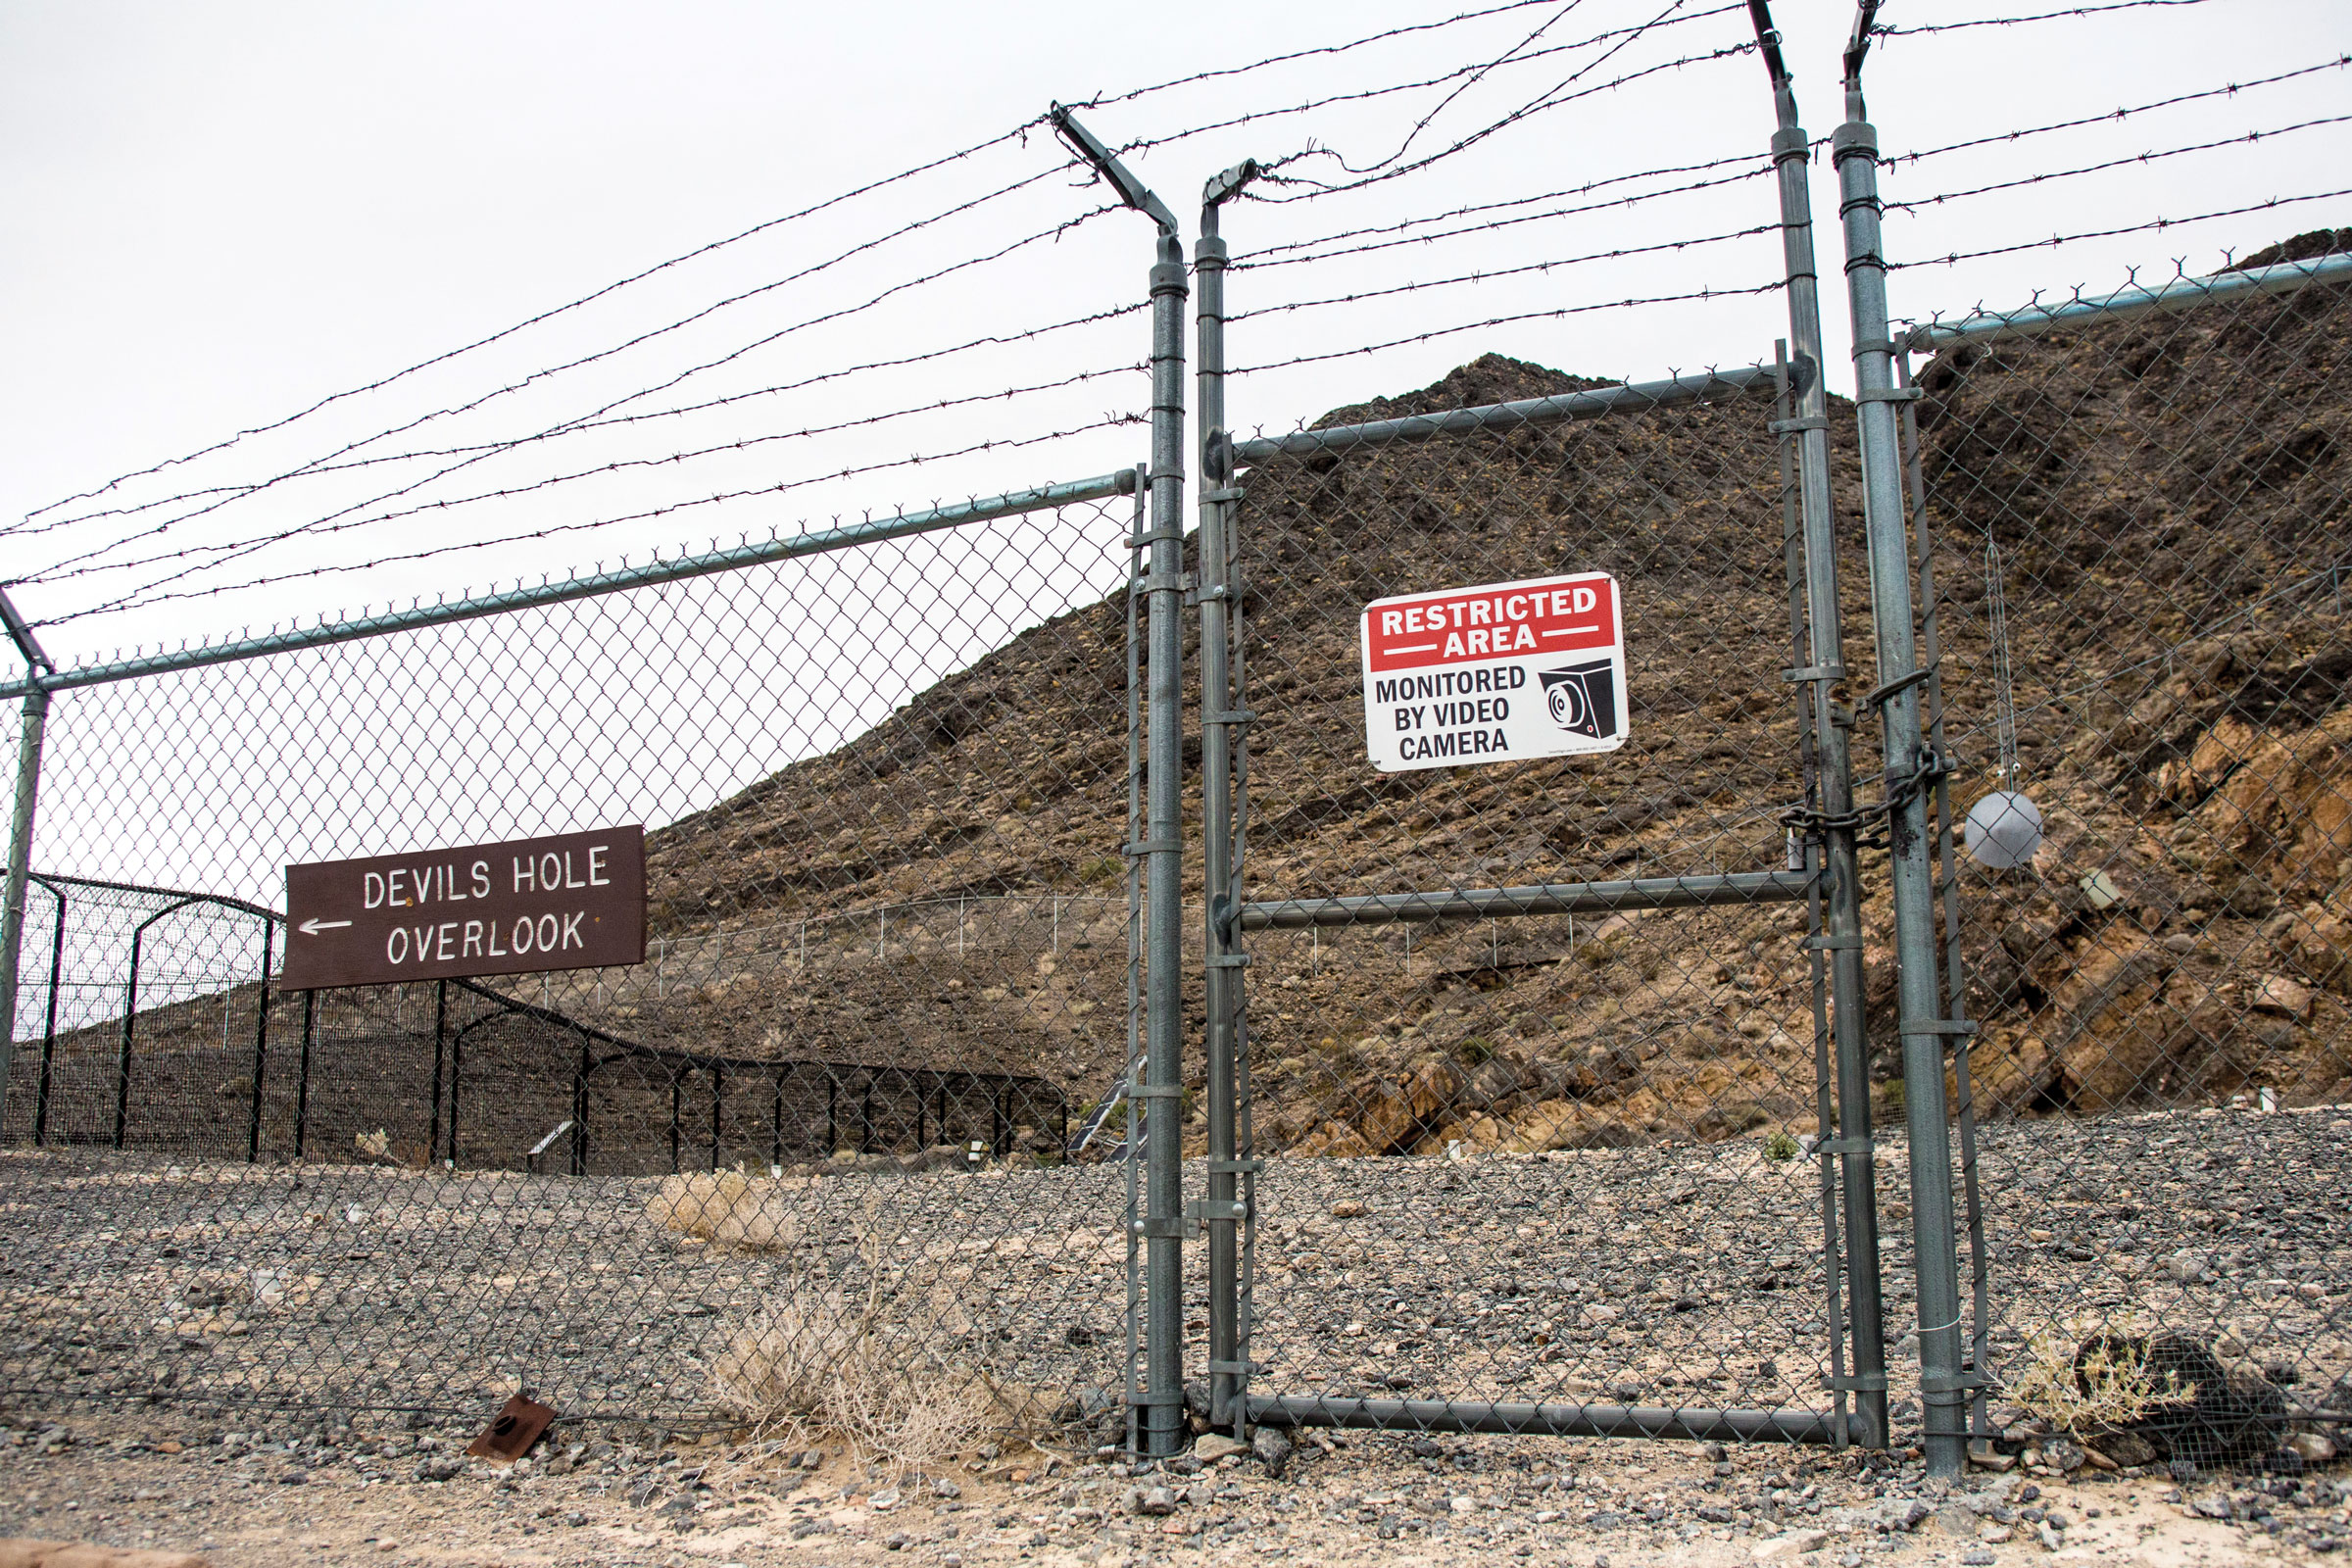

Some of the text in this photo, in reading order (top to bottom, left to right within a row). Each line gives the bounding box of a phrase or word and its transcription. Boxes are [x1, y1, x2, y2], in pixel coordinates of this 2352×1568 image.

[1382, 587, 1597, 636] RESTRICTED
[1443, 623, 1538, 659] AREA
[1375, 665, 1526, 704] MONITORED
[1395, 697, 1510, 732] BY VIDEO
[1399, 728, 1509, 760] CAMERA
[364, 845, 611, 909] DEVILS HOLE
[386, 910, 586, 965] OVERLOOK
